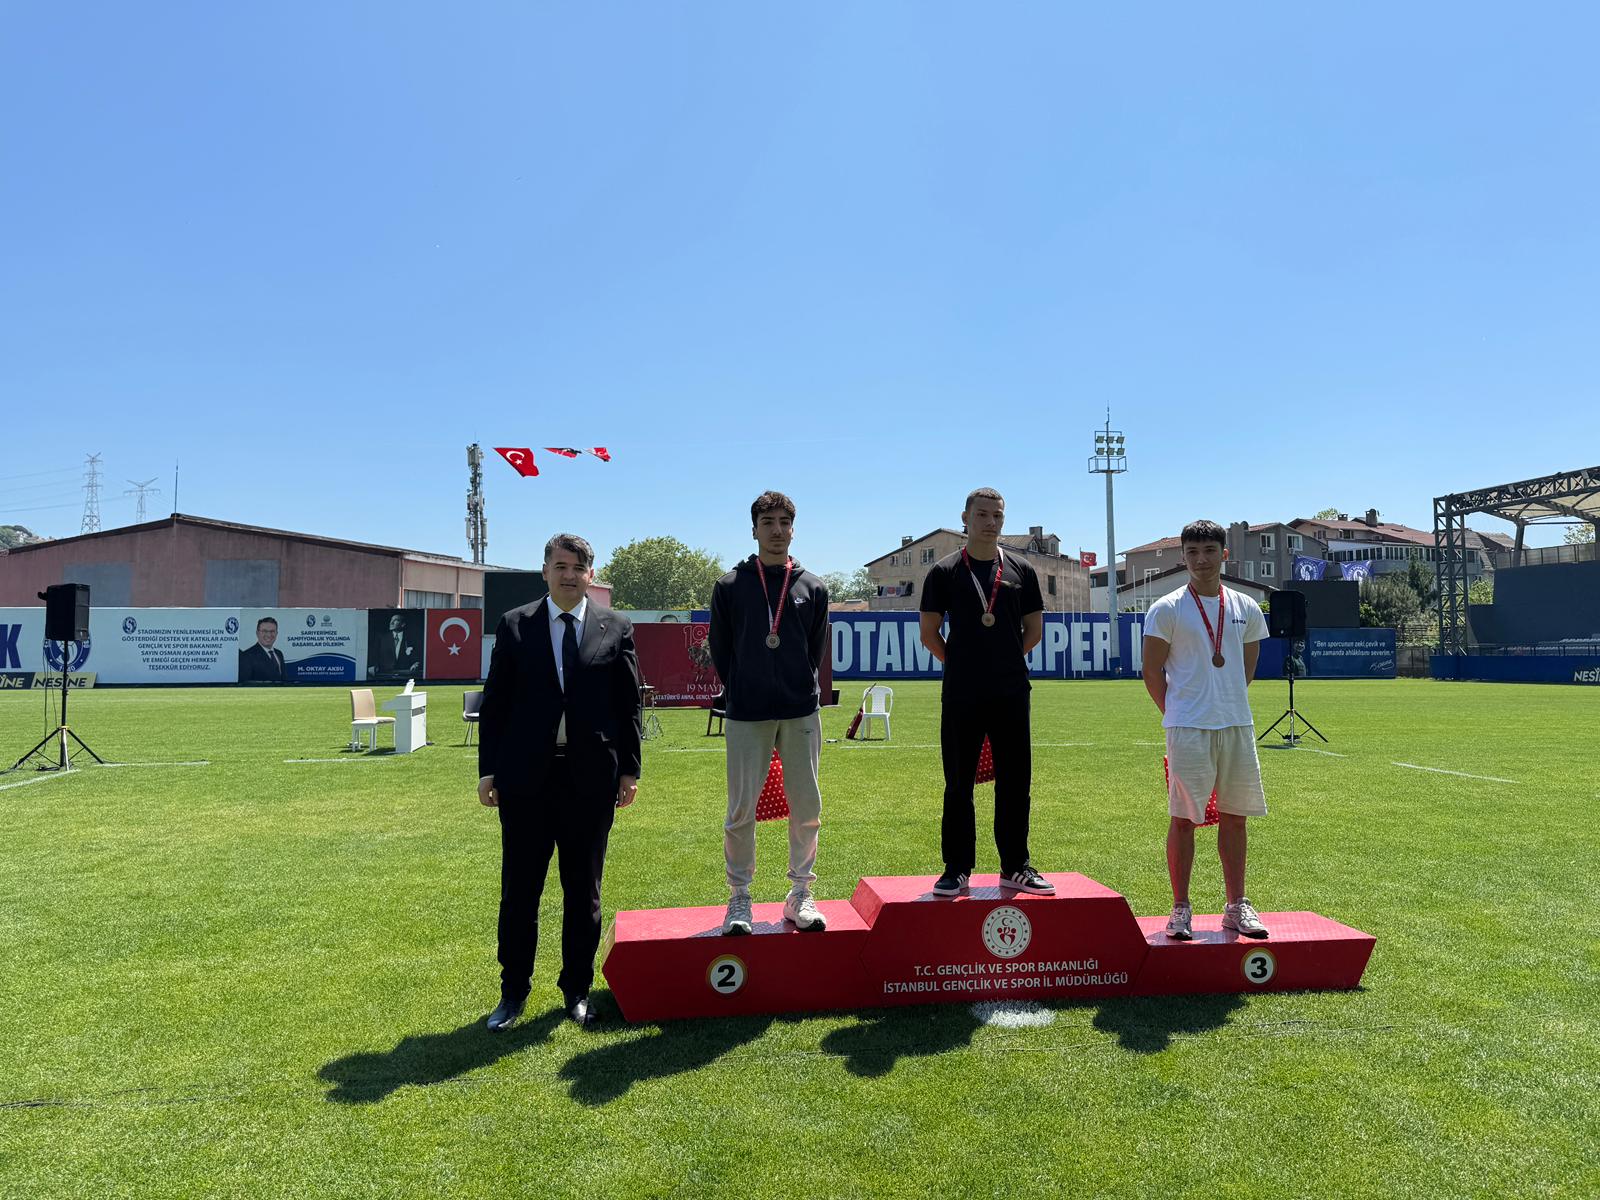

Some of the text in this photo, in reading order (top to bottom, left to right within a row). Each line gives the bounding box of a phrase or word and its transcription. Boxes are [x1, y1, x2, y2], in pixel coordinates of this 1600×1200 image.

[212, 628, 224, 636] İÇİN
[832, 621, 946, 672] OTAM
[34, 677, 87, 688] NESNE
[697, 683, 722, 692] MAYI
[717, 964, 736, 987] 2
[914, 958, 1099, 977] T.C. GENÇLİK VE SPOR BAKANLIĞI
[1250, 956, 1268, 978] 3
[883, 972, 1128, 993] İSTANBUL GENÇLİK VE SPOR İL MÜDÜRLÜĞÜ
